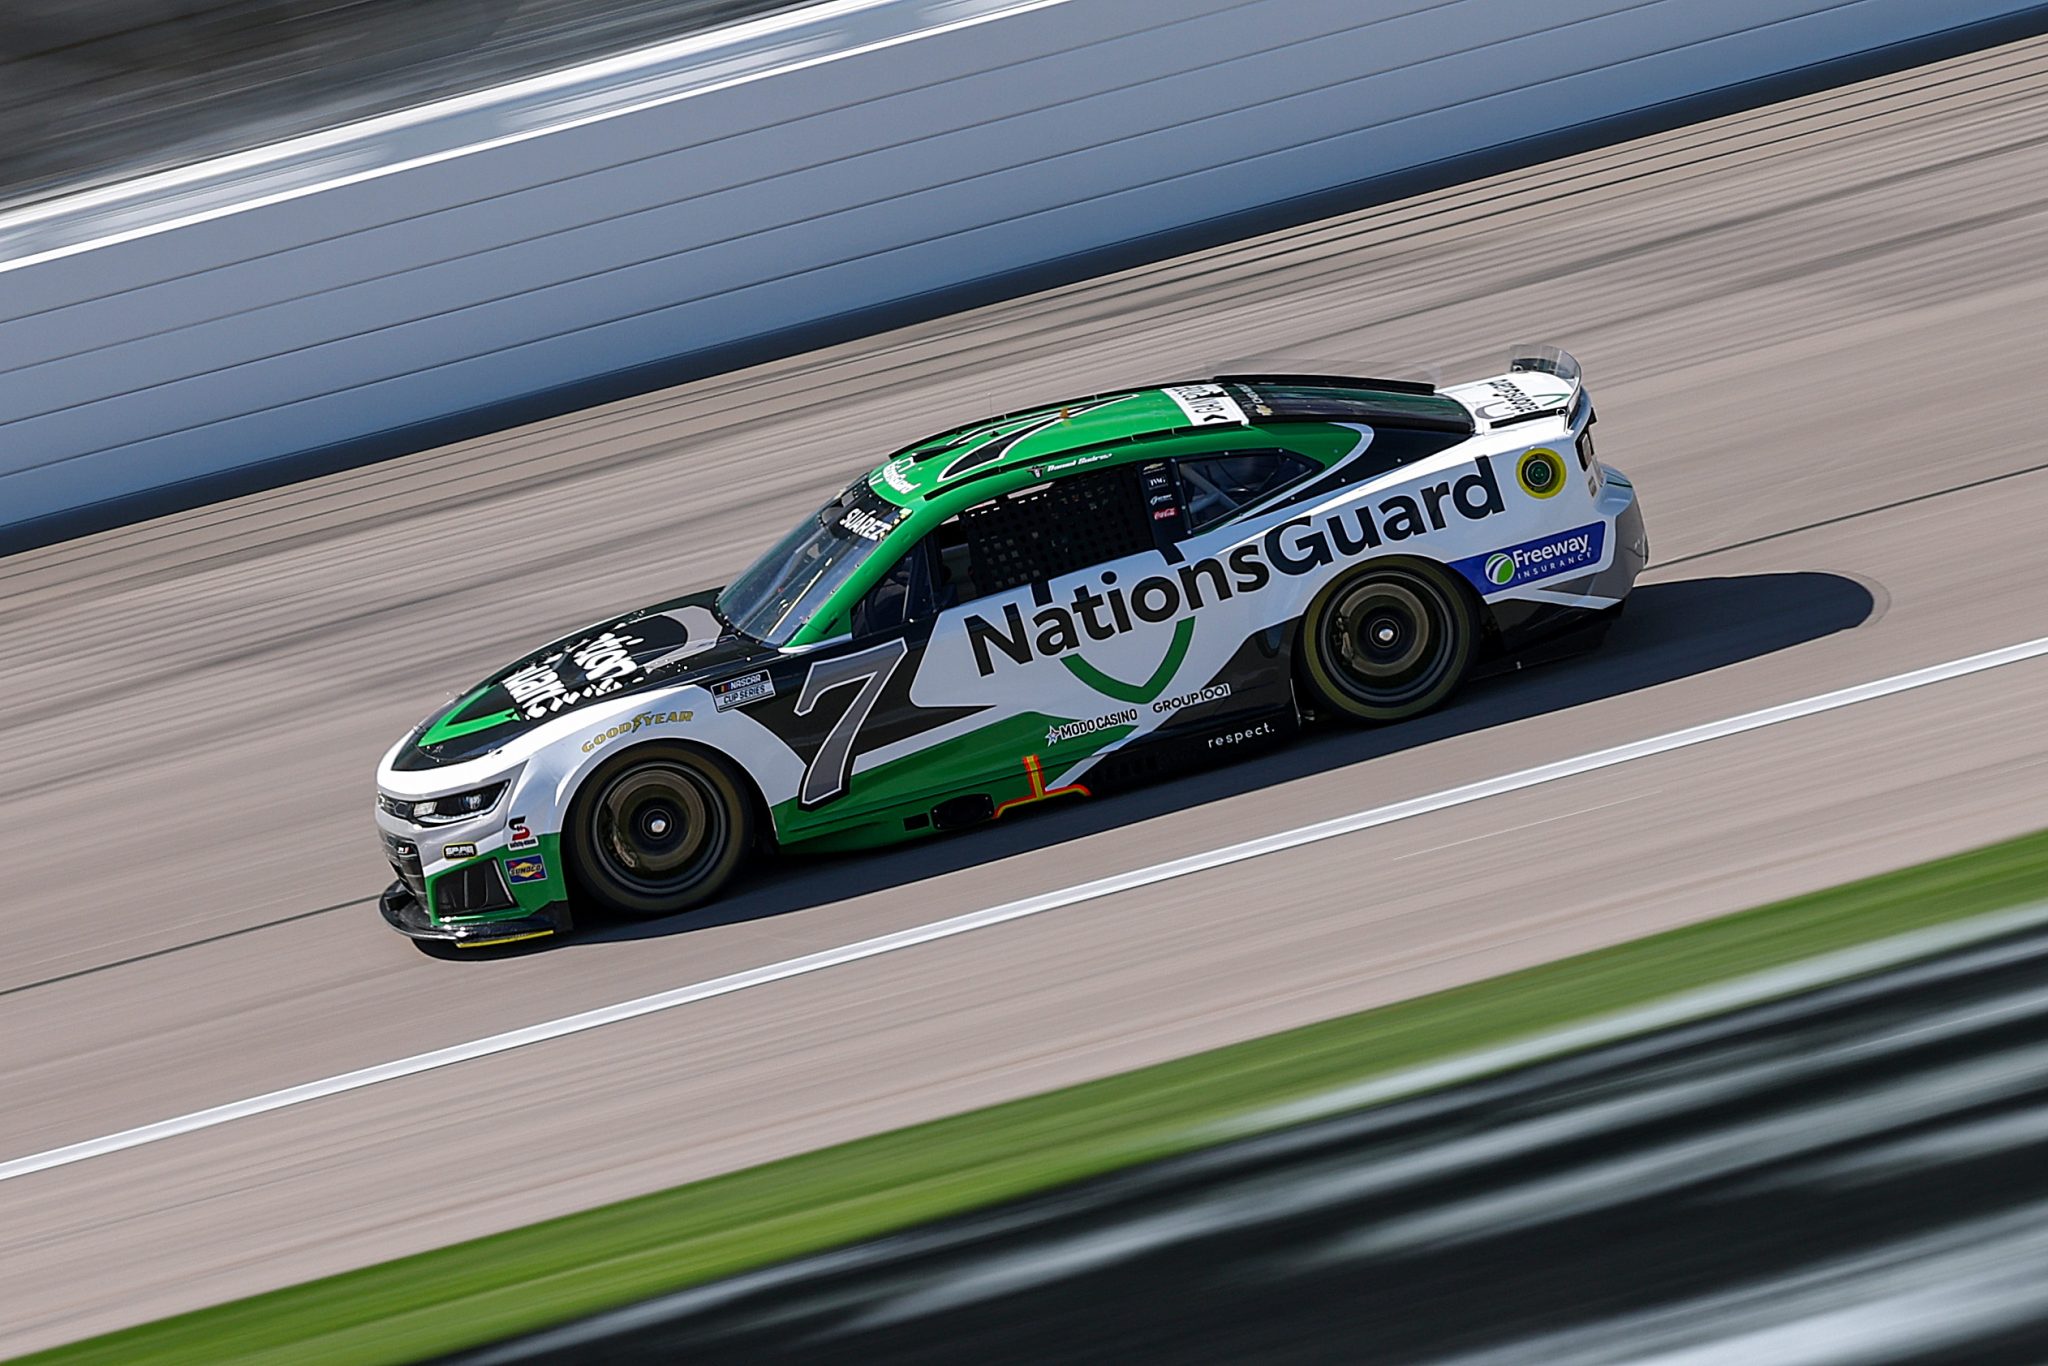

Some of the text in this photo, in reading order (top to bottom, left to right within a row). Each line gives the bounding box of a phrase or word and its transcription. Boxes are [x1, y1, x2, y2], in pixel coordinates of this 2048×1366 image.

[840, 508, 892, 541] SUÁREZ
[1513, 534, 1589, 568] Freeway
[1517, 552, 1592, 579] INSURANCE
[963, 455, 1506, 677] NationsGuard
[723, 684, 766, 704] CUP SERIES
[730, 673, 762, 690] NASCAR
[1152, 685, 1230, 713] GROUP1001
[581, 710, 694, 753] GOODYEAR
[793, 636, 908, 808] 7
[1060, 708, 1138, 739] MODO CASINO
[1207, 722, 1276, 748] respect.
[510, 863, 543, 877] SUNOCO
